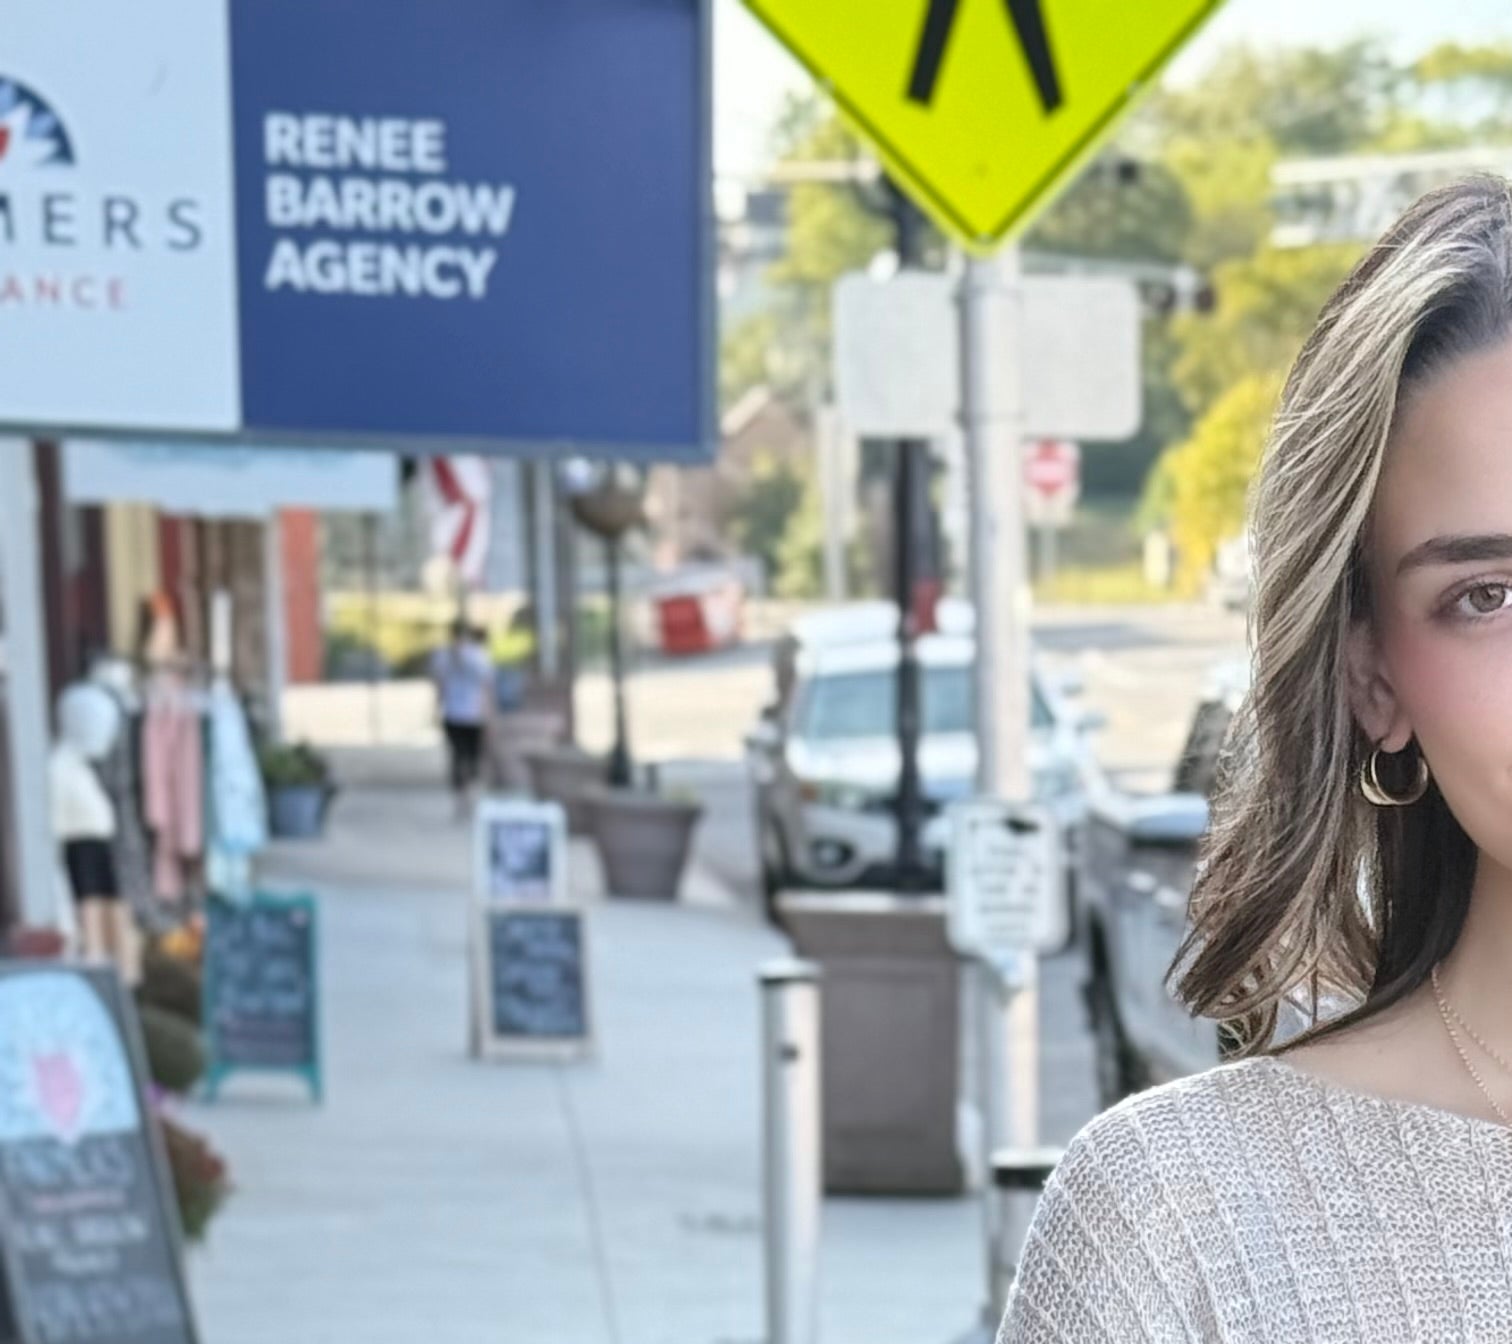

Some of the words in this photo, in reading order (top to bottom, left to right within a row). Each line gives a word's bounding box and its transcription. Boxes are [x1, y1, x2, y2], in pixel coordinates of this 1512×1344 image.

[265, 113, 447, 173] RENEE
[266, 174, 515, 237] BARROW
[265, 238, 497, 299] AGENCY
